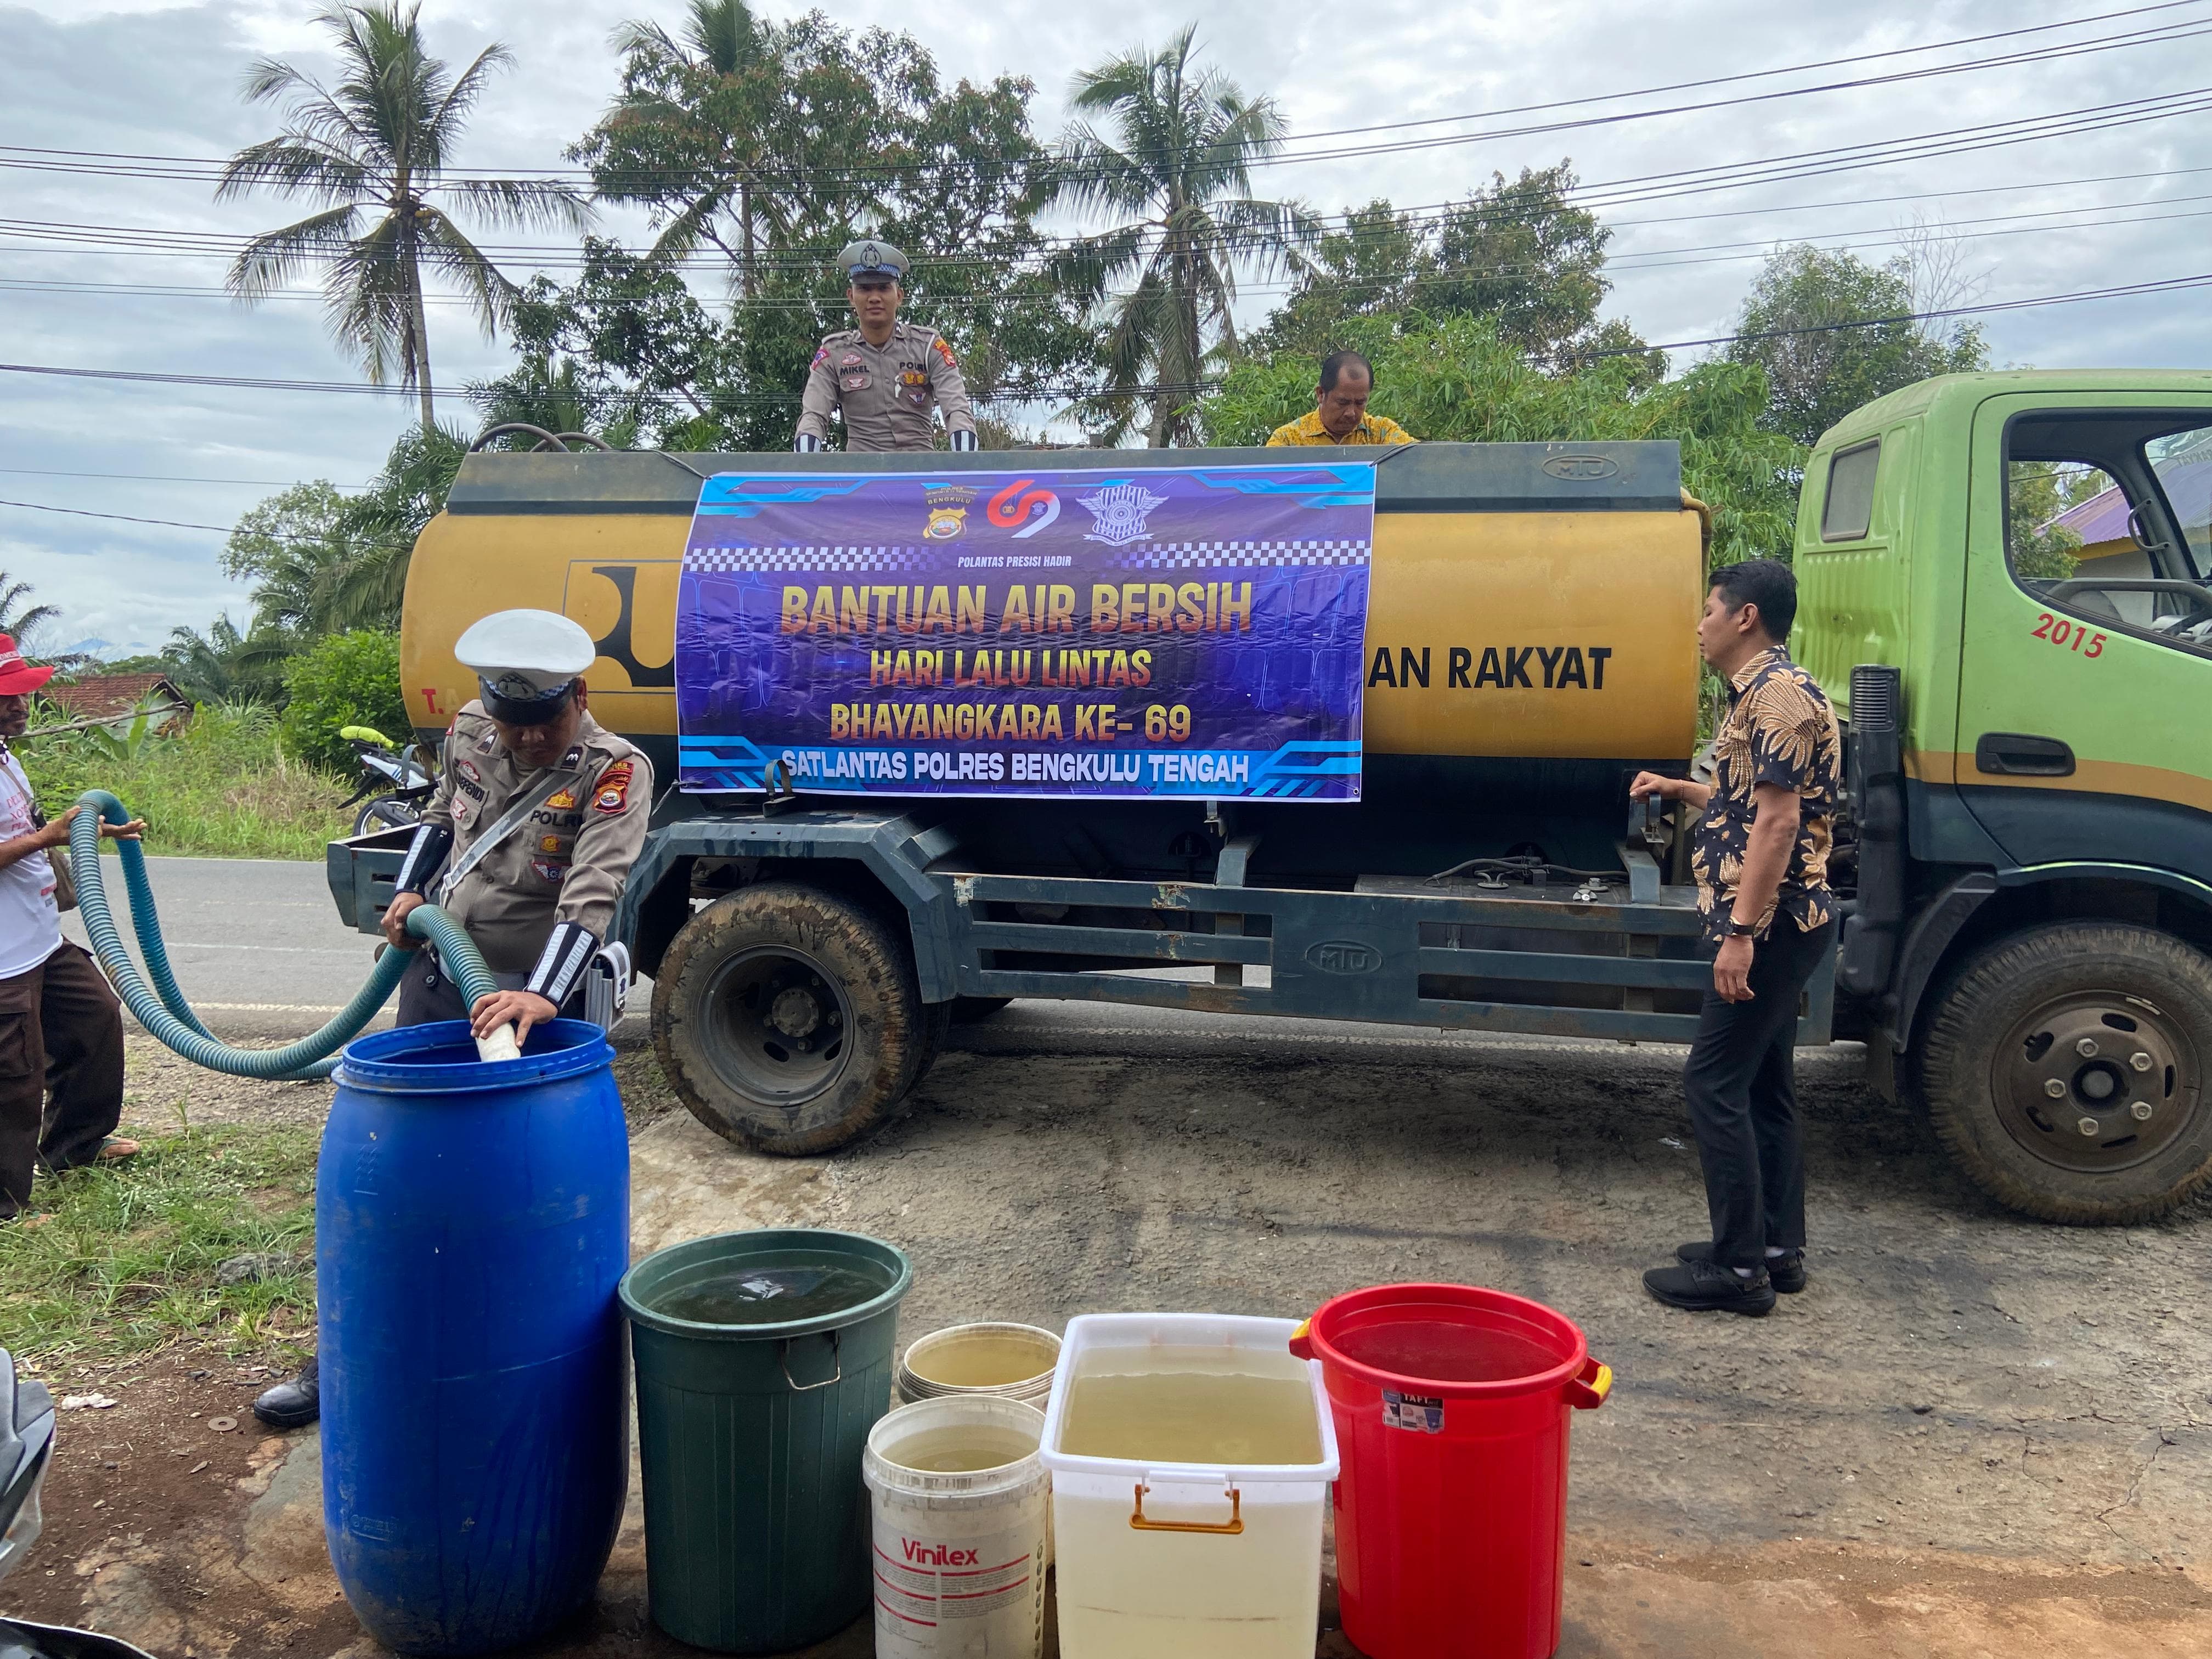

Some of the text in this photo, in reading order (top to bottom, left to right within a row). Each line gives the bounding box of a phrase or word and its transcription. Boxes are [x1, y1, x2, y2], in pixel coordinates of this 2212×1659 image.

[840, 365, 870, 376] MIKEL
[928, 496, 971, 505] BENGKULU
[958, 555, 1072, 568] POLANTAS PRESISI HADIR
[781, 582, 1251, 634] BANTUAN AIR BERSIH
[2031, 613, 2107, 658] 2015
[870, 650, 1152, 687] HARI LALU LINTAS
[1448, 647, 1612, 690] RAKYAT
[831, 703, 1191, 742] BHAYANGKARA KE- 69
[782, 749, 1249, 783] SATLANTAS POLRES BENGKULU TENGAH
[1403, 1393, 1429, 1403] TAFT
[902, 1537, 980, 1566] Vinilex
